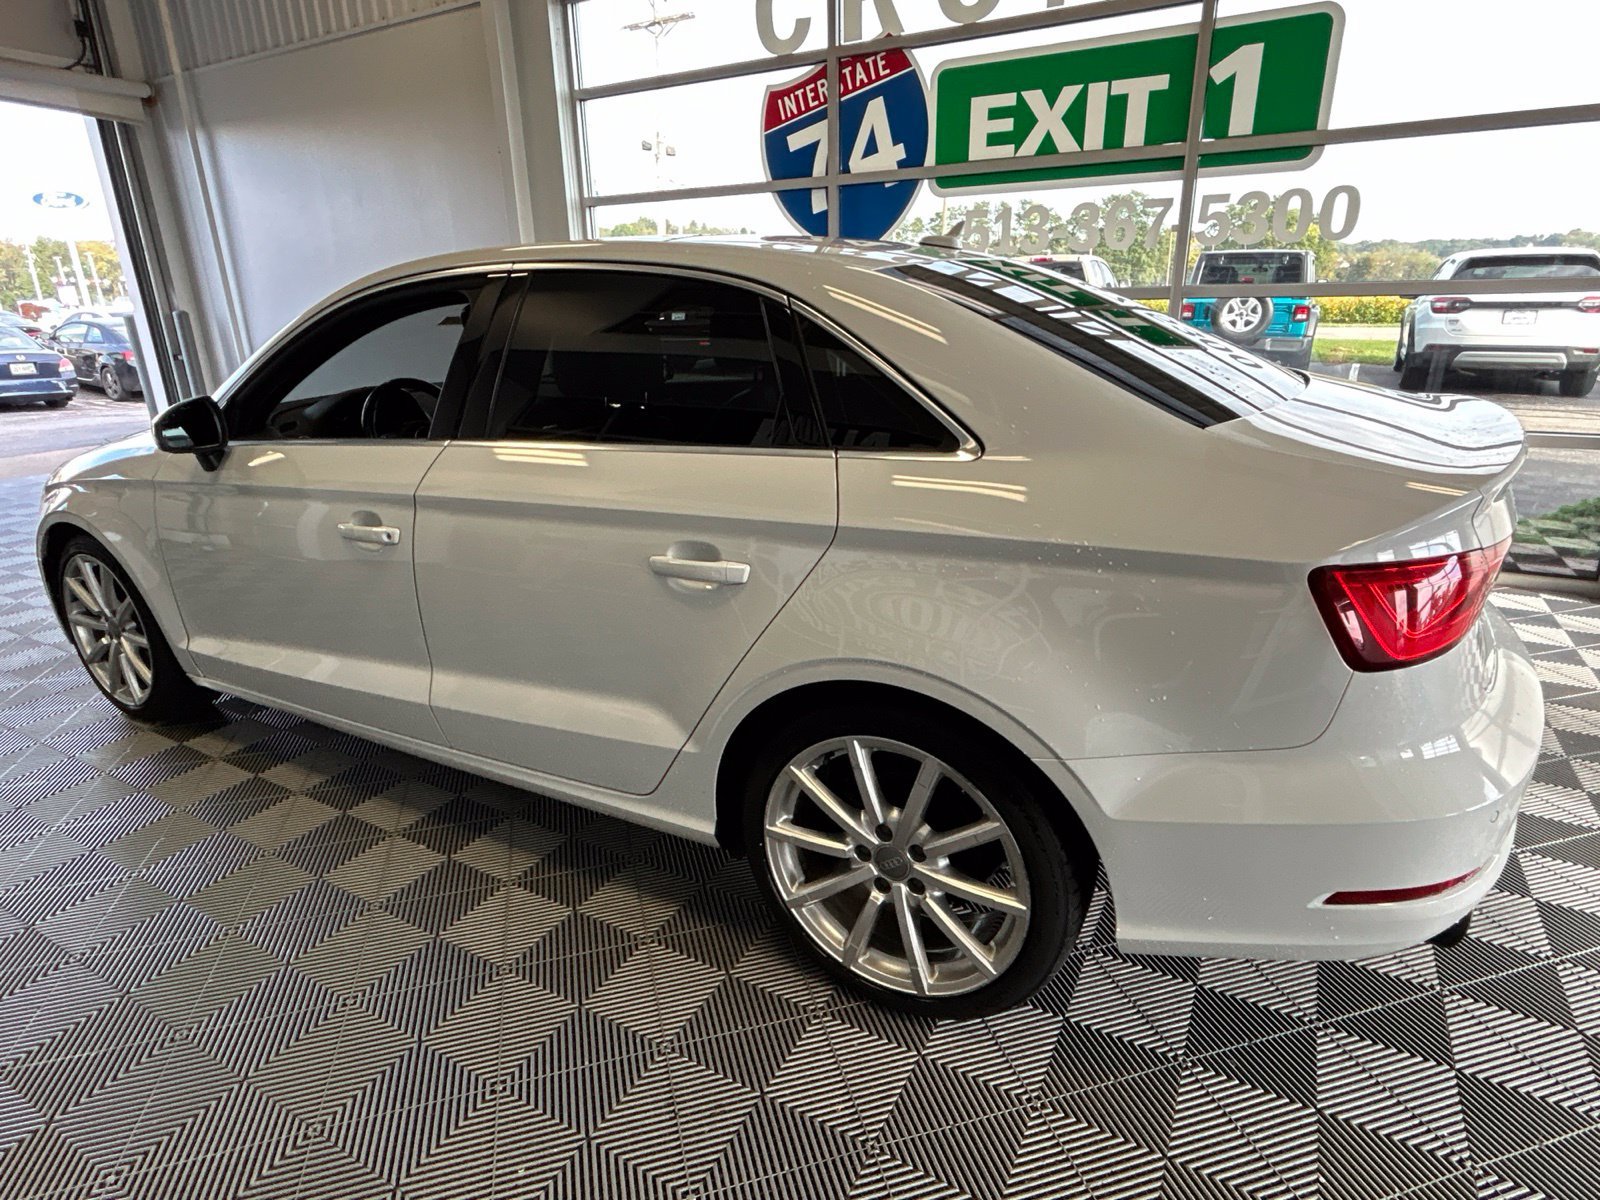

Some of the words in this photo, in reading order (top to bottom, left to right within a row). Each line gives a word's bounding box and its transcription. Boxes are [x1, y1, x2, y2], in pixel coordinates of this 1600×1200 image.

[778, 52, 891, 121] INTERTATE
[968, 73, 1171, 161] EXIT
[1209, 42, 1265, 138] 1
[787, 95, 907, 215] 74
